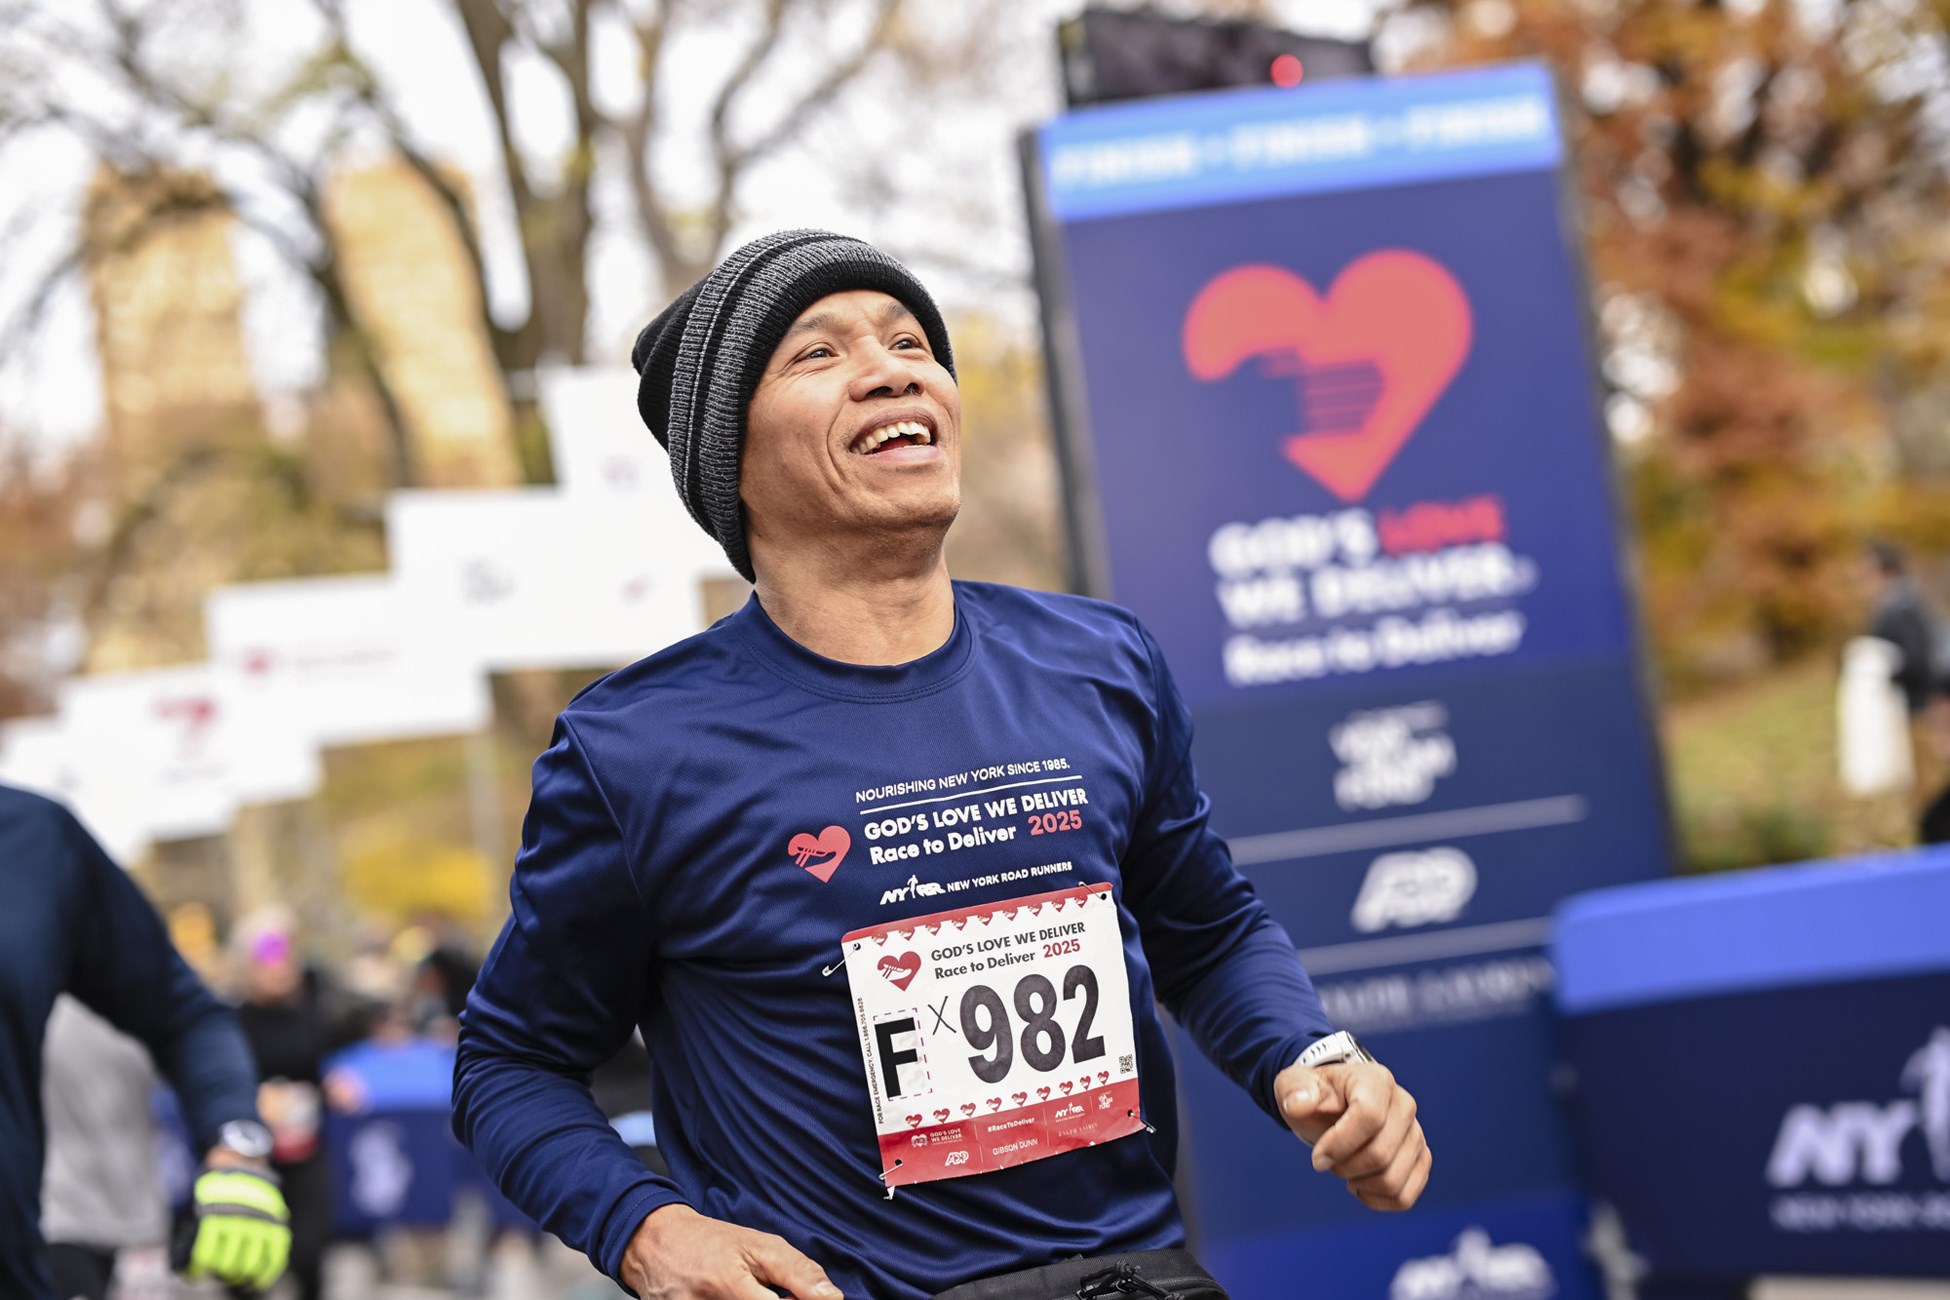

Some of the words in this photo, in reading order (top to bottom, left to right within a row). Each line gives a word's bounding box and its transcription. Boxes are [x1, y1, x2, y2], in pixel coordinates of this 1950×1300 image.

[856, 778, 936, 803] NOURISHING
[939, 772, 968, 790] NEW
[971, 765, 1005, 783] YORK
[1007, 761, 1041, 775] SINCE
[1042, 757, 1070, 771] 1985.
[864, 814, 930, 841] GOD'S
[933, 804, 982, 829] LOVE
[984, 798, 1018, 818] WE
[1021, 788, 1088, 812] DELIVER
[869, 842, 920, 865] Race
[923, 837, 945, 856] to
[948, 825, 1017, 850] Deliver
[1027, 810, 1083, 836] 2025
[947, 880, 970, 893] NEW
[972, 874, 1000, 888] YORK
[1001, 868, 1029, 883] ROAD
[1030, 861, 1073, 877] RUNNERS
[931, 943, 974, 962] GOD'S
[977, 936, 1011, 953] LOVE
[1014, 931, 1037, 945] WE
[1039, 922, 1085, 941] DELIVER
[935, 965, 967, 979] Race
[970, 961, 985, 973] to
[987, 952, 1036, 969] Deliver
[1042, 938, 1081, 959] 2025
[960, 964, 1106, 1084] 982
[865, 1042, 873, 1057] CALL
[874, 1017, 918, 1098] F
[944, 1150, 969, 1166] ADP
[992, 1143, 1018, 1156] GIBSON
[1019, 1138, 1038, 1149] DUNN
